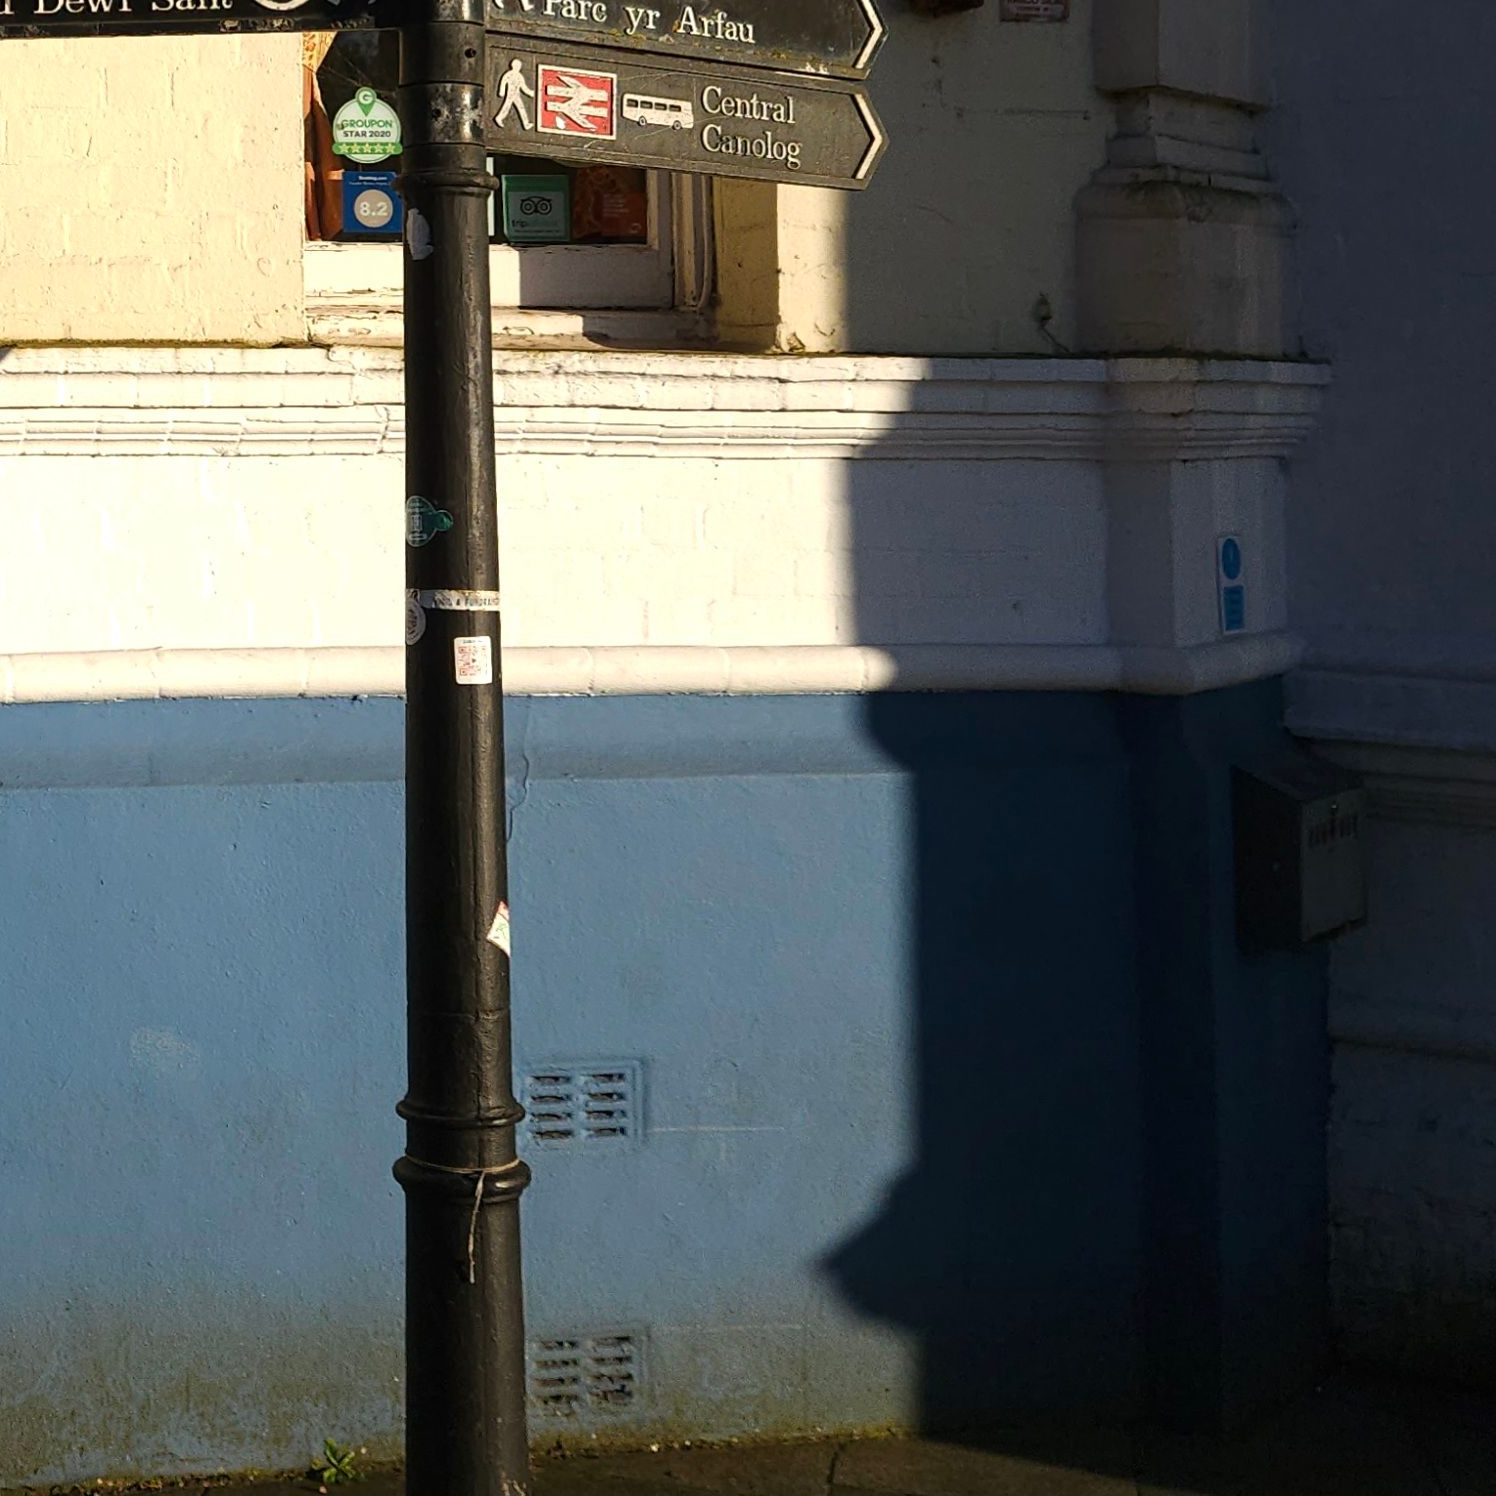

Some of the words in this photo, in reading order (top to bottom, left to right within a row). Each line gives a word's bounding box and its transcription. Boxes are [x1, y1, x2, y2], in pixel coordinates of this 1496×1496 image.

[625, 6, 661, 35] yr
[676, 7, 756, 44] Arfau
[702, 86, 796, 125] Central
[341, 119, 392, 128] GROUPON
[369, 130, 391, 138] 2020
[701, 124, 803, 169] Canolog
[359, 202, 388, 216] 8.2
